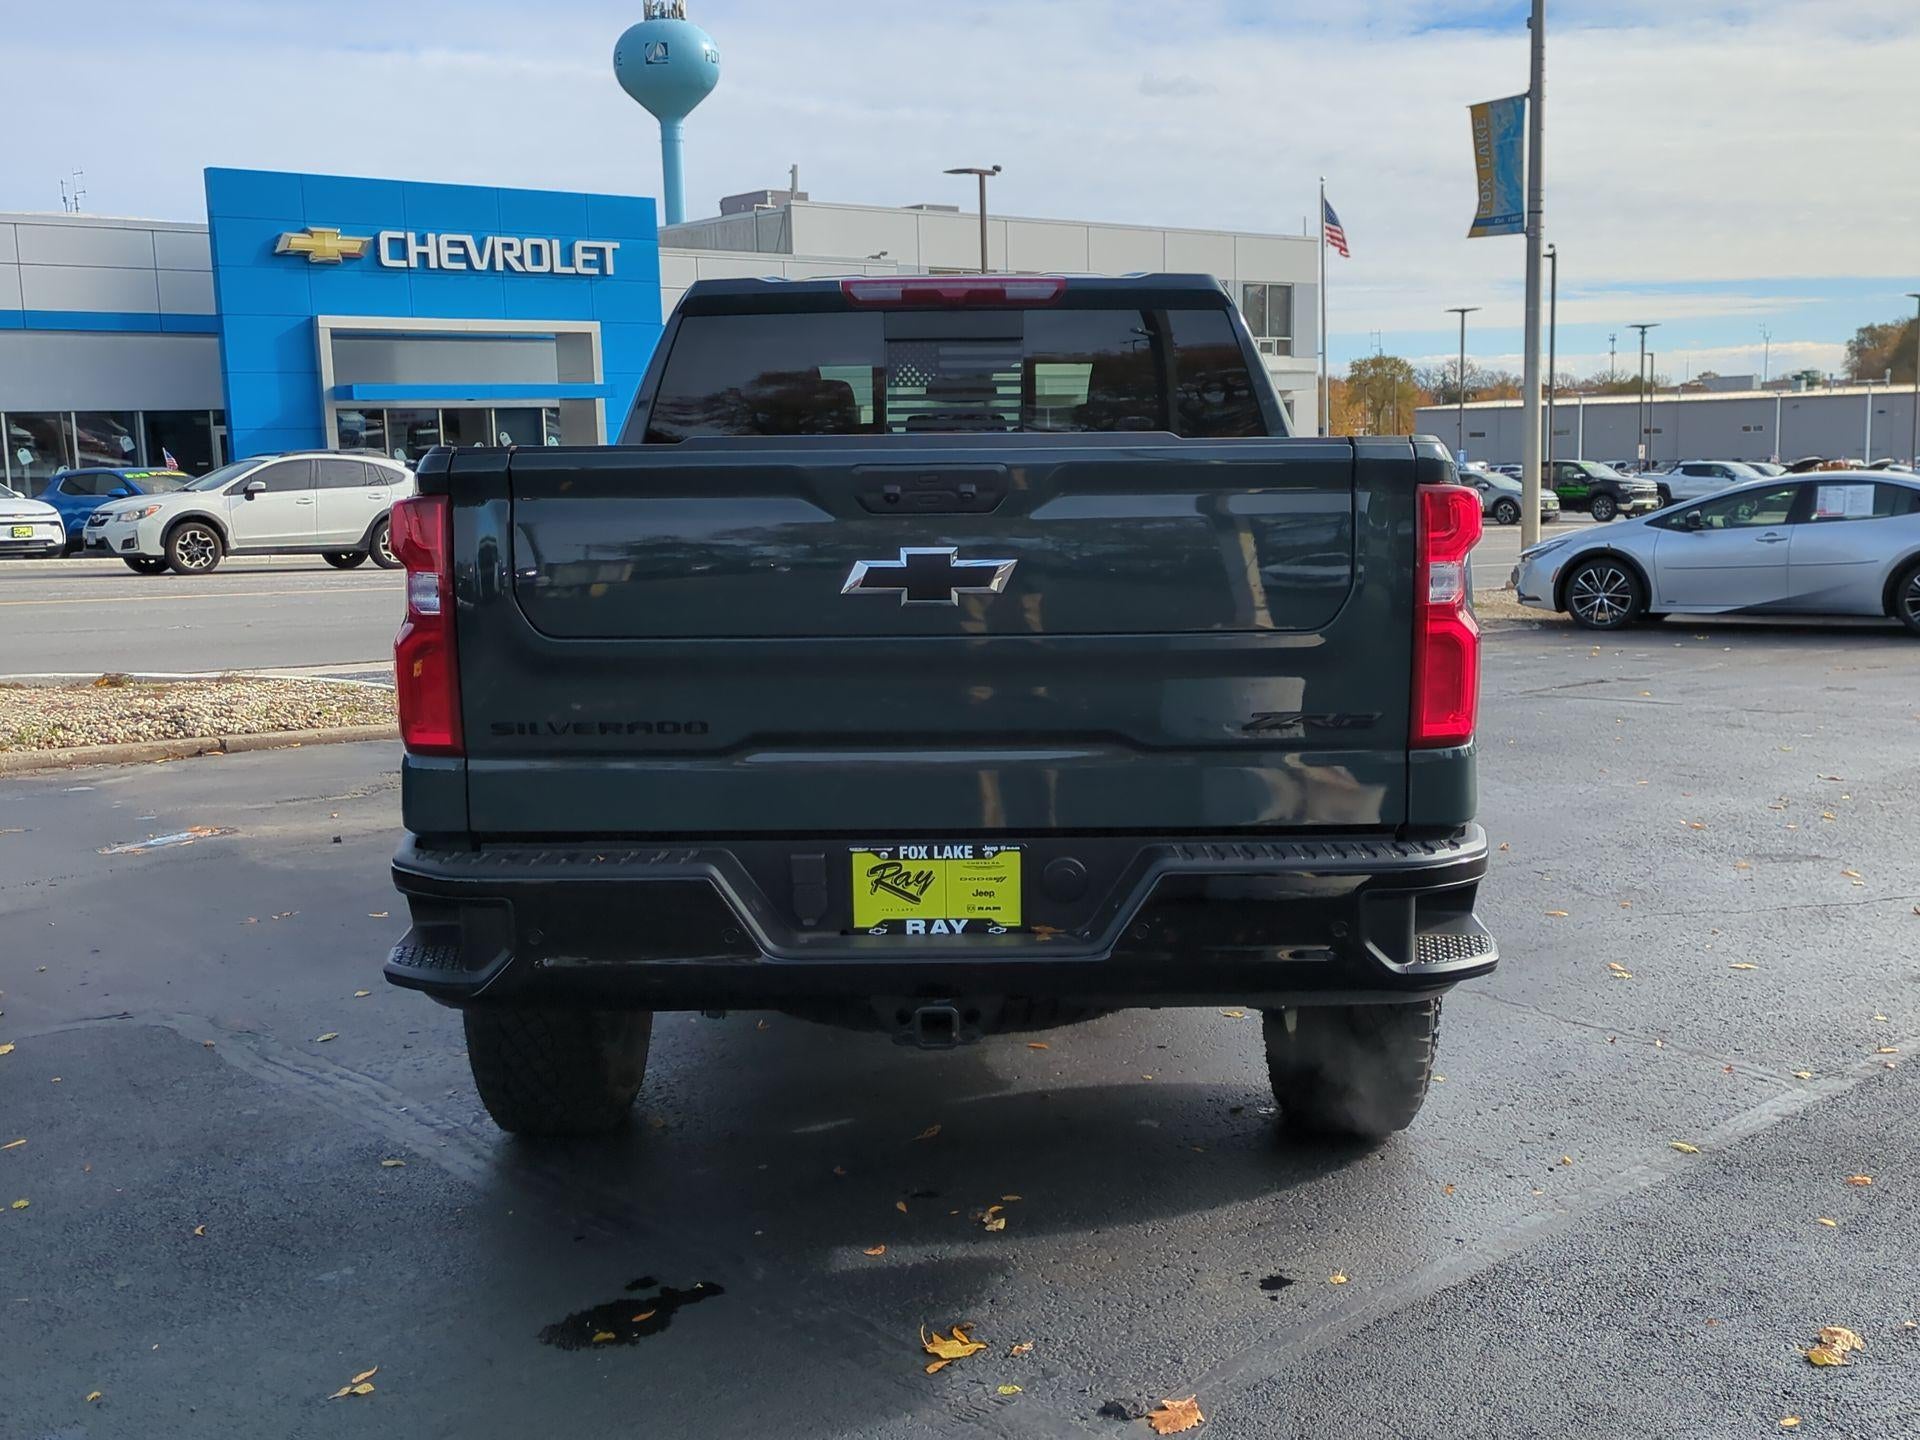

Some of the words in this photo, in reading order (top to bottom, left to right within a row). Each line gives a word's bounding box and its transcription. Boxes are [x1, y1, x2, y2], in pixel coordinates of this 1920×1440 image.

[1474, 118, 1491, 168] LAKE
[1479, 177, 1492, 214] FOX
[378, 230, 620, 275] CHEVROLET
[490, 721, 709, 736] SILVERADO
[899, 845, 929, 860] FOX
[934, 845, 973, 860] LAKE
[867, 861, 936, 898] Ray
[972, 888, 995, 899] Jeep
[906, 919, 969, 935] RAY
